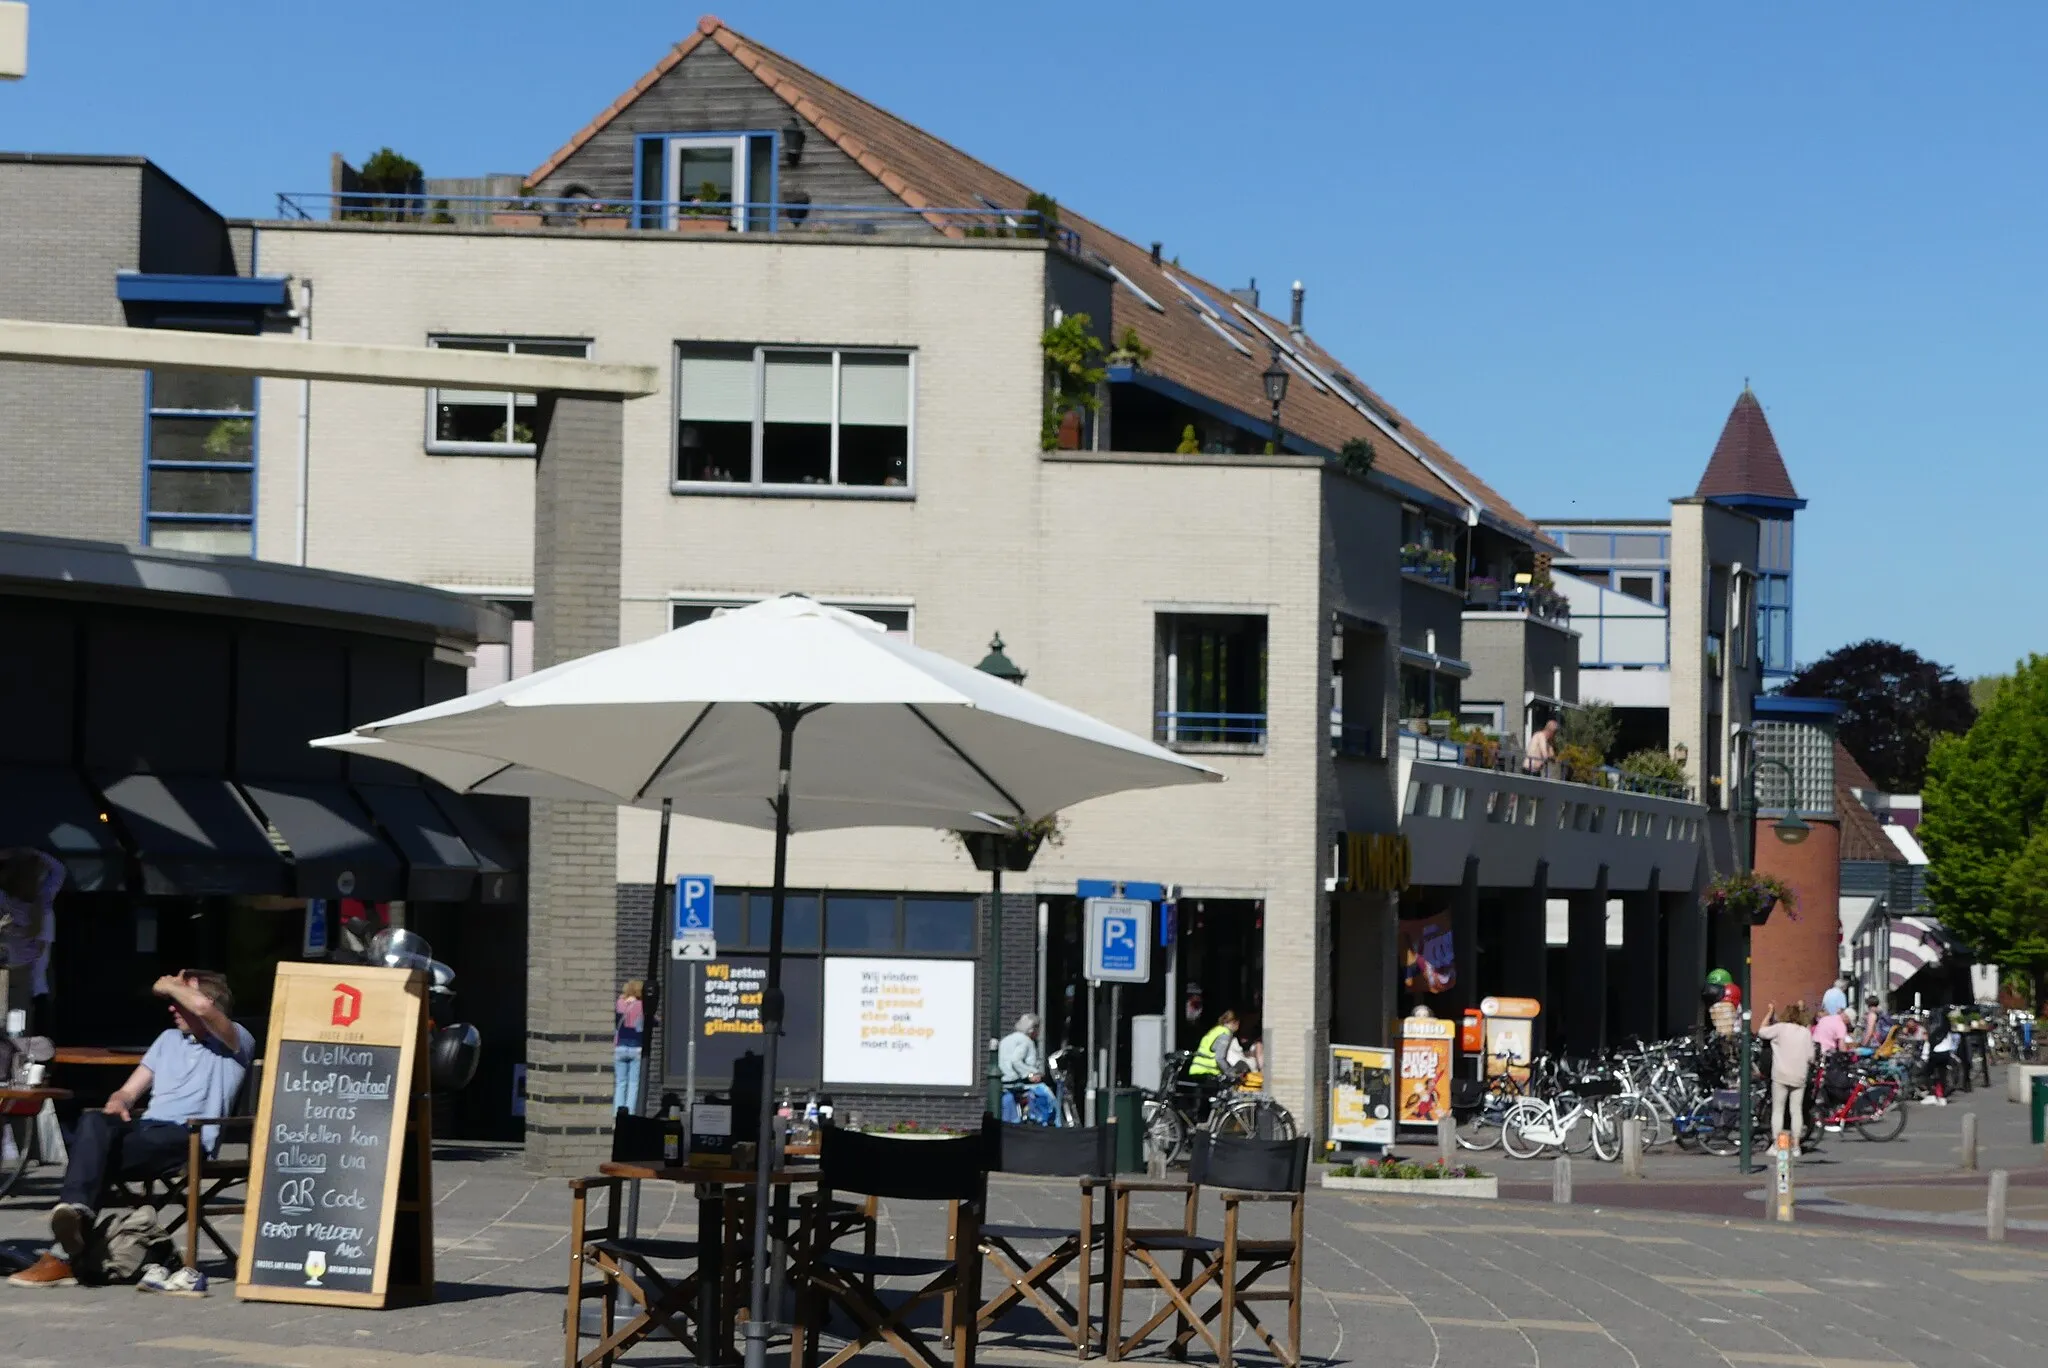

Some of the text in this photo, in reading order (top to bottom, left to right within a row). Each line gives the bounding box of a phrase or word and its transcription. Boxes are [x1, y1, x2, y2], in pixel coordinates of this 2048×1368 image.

[684, 880, 705, 909] P
[1105, 920, 1127, 948] P
[706, 964, 766, 981] Wij zetten
[861, 971, 919, 984] Wij vinden
[705, 980, 760, 993] graag een
[861, 984, 921, 994] dat lekker
[705, 992, 763, 1007] stapje ext
[876, 998, 924, 1011] gezond
[704, 1006, 759, 1021] Altijd met
[891, 1012, 911, 1021] ook
[861, 1022, 935, 1039] goedkoop
[861, 1040, 888, 1048] moet
[302, 1045, 374, 1066] Welkom
[337, 1071, 391, 1102] Digitaal
[304, 1097, 357, 1120] terras
[275, 1123, 342, 1143] Bestellen
[276, 1145, 367, 1170] alleen via
[279, 1177, 316, 1207] QR
[261, 1221, 304, 1240] EERST
